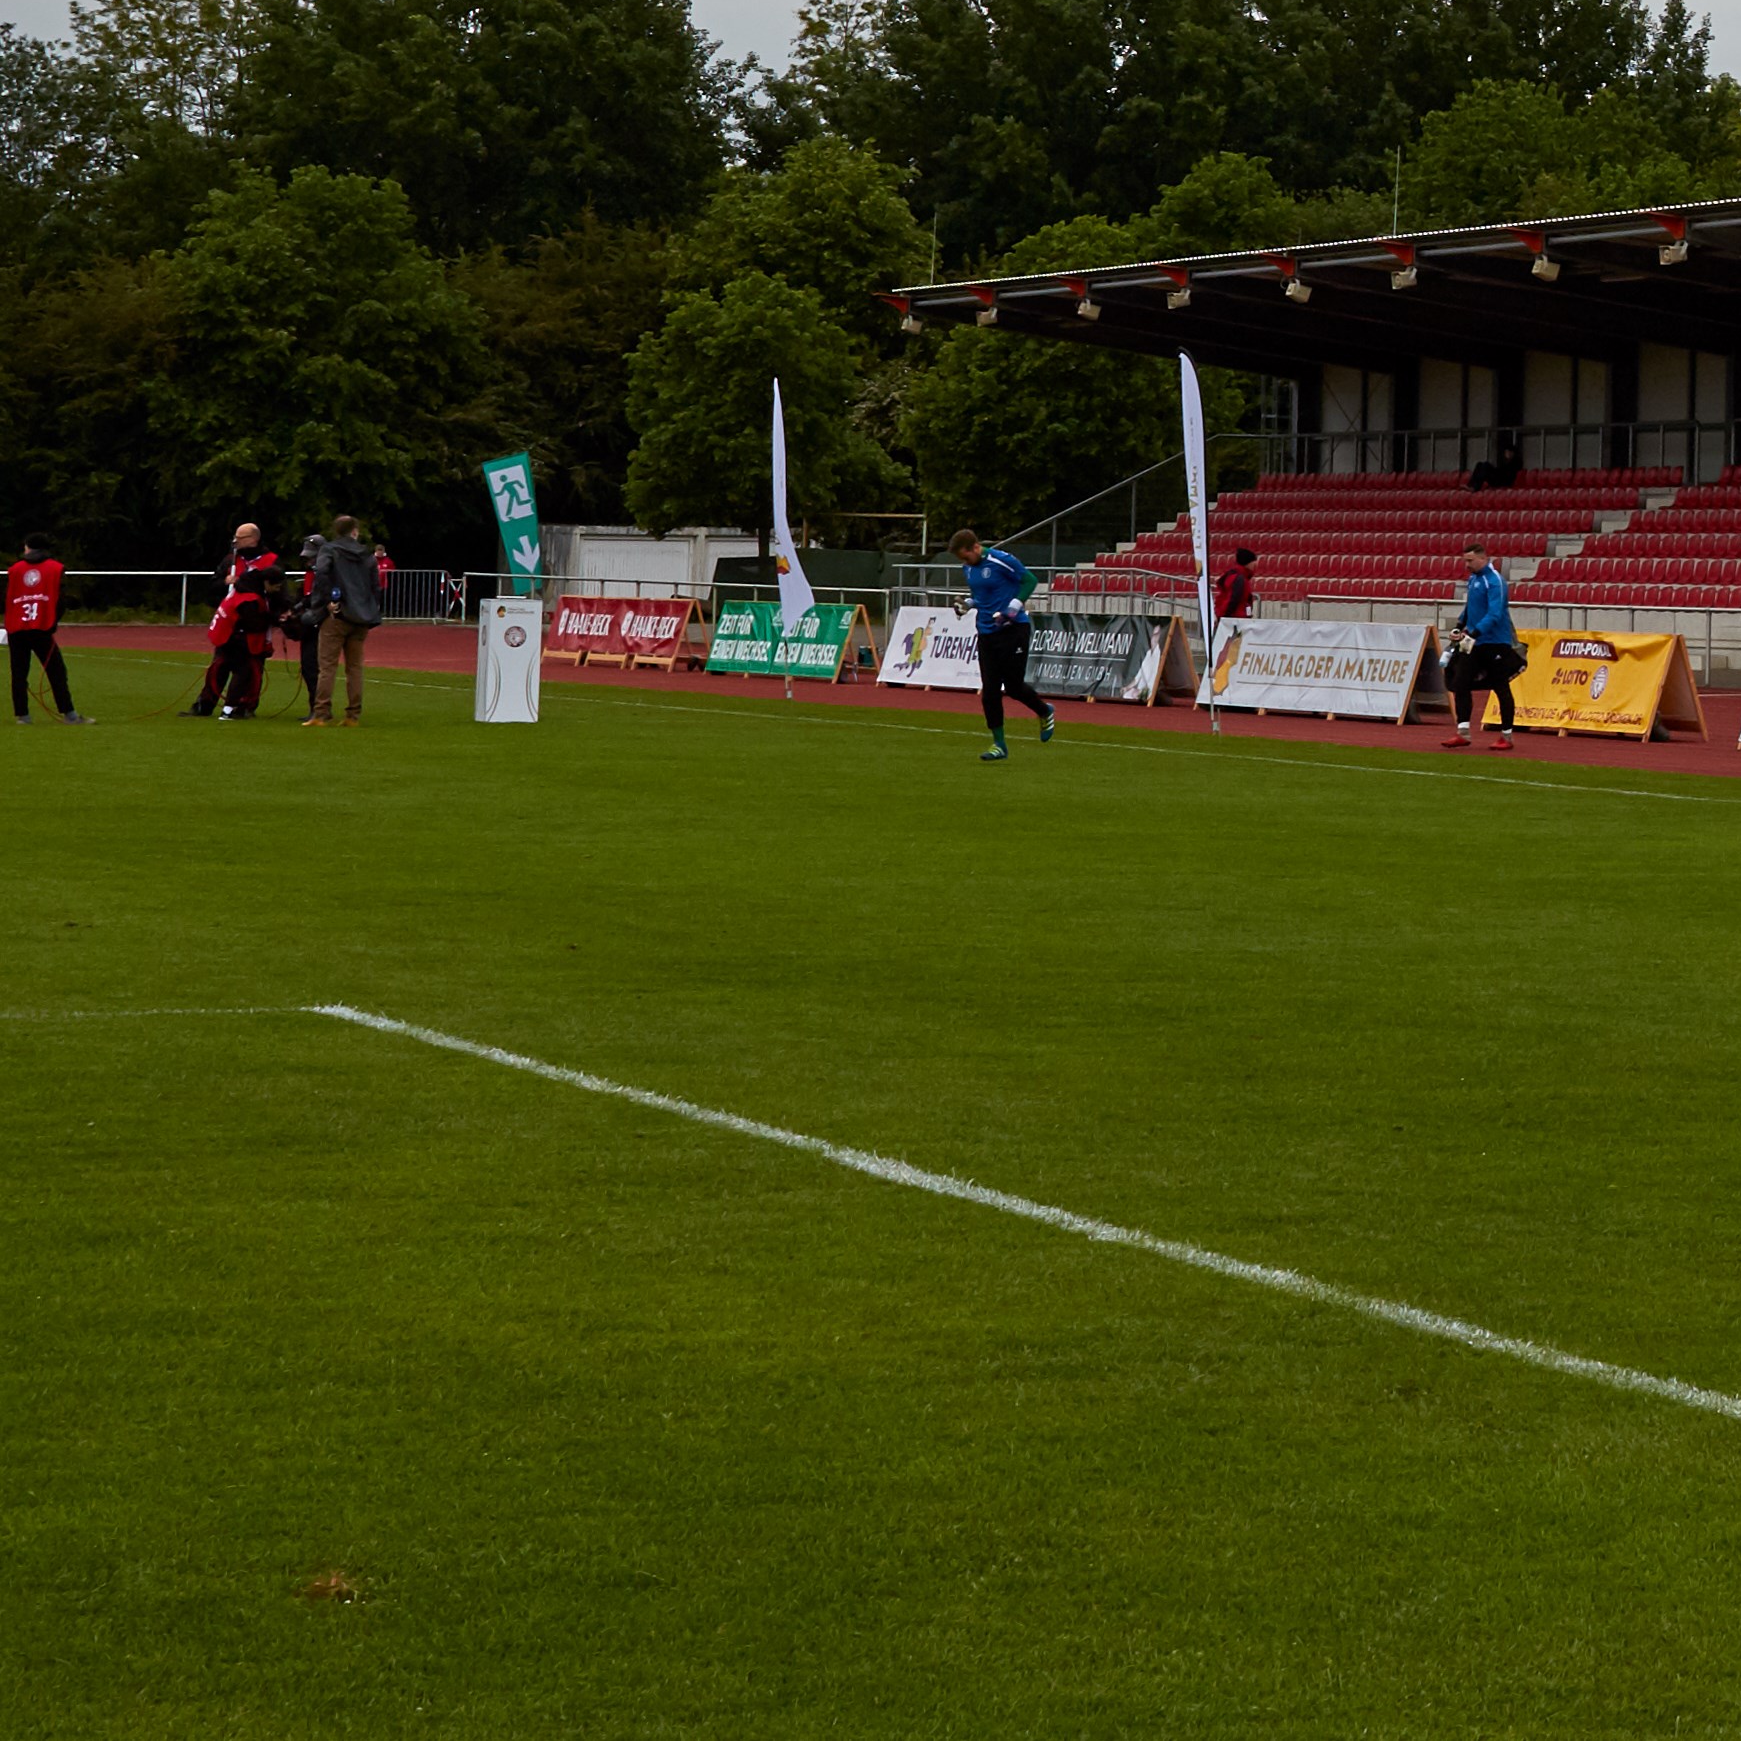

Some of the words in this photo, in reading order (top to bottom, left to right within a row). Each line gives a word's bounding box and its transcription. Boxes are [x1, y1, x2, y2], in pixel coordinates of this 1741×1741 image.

[717, 614, 739, 635] ZEIT
[710, 639, 736, 660] EINEN
[733, 640, 772, 662] WECHSEL
[1030, 630, 1071, 653] FLORIAN
[1074, 631, 1133, 655] WELLMANN
[799, 643, 839, 666] WECHSEL
[1238, 652, 1303, 677] FINALTAG
[1304, 655, 1335, 679] DER
[1333, 657, 1410, 684] AMATEURE
